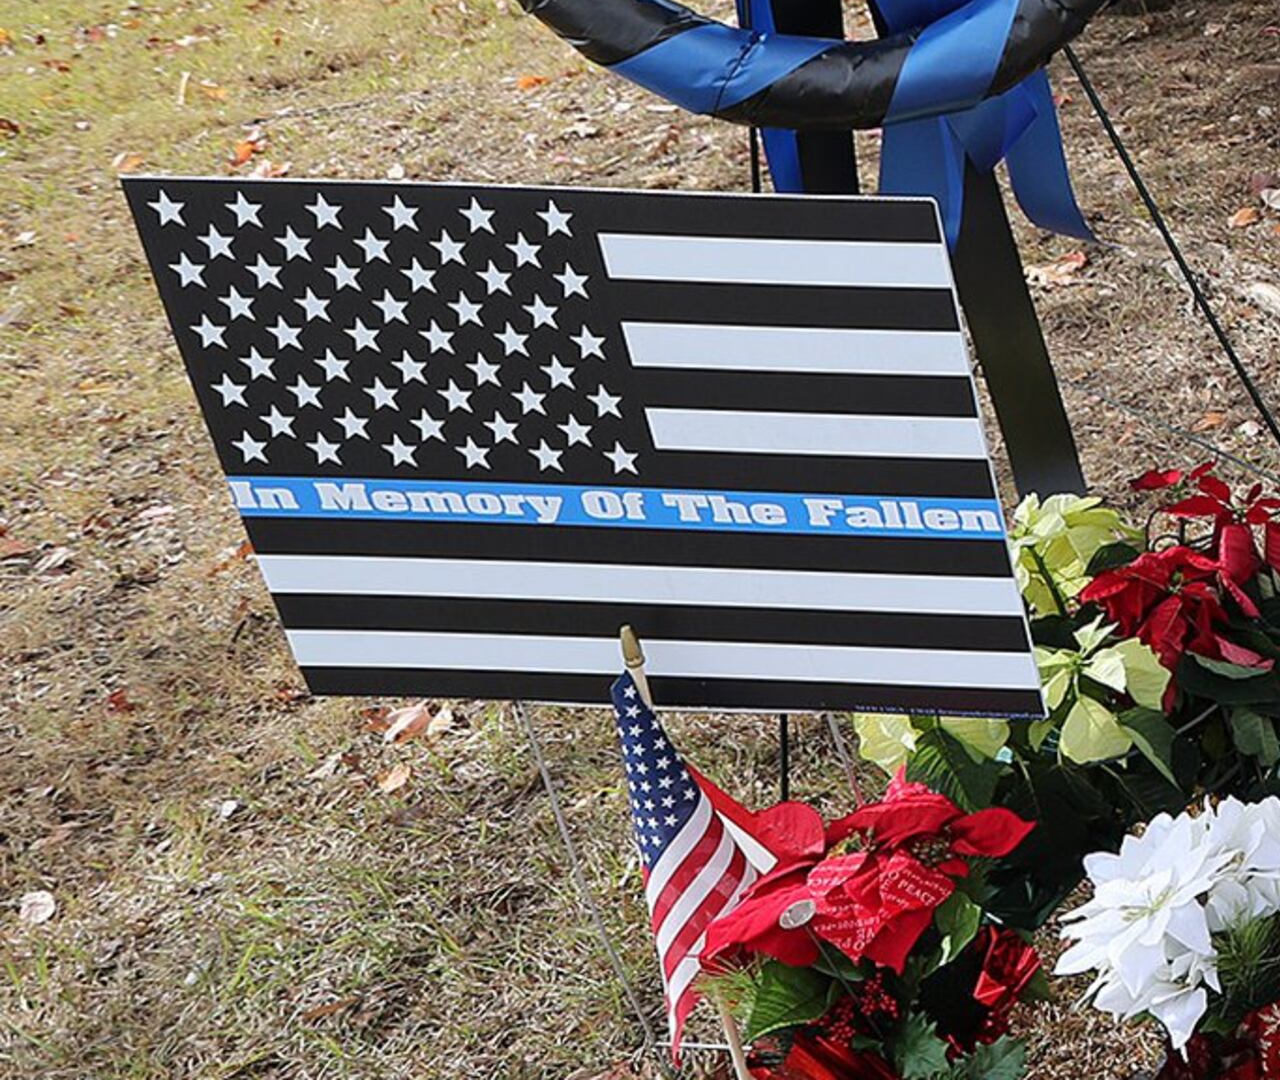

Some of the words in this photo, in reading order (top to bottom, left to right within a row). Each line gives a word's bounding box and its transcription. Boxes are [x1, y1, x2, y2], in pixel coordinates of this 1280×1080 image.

[228, 480, 300, 510] In
[312, 482, 564, 524] Memory
[581, 490, 647, 520] Of
[661, 493, 788, 525] The
[803, 498, 1001, 531] Fallen
